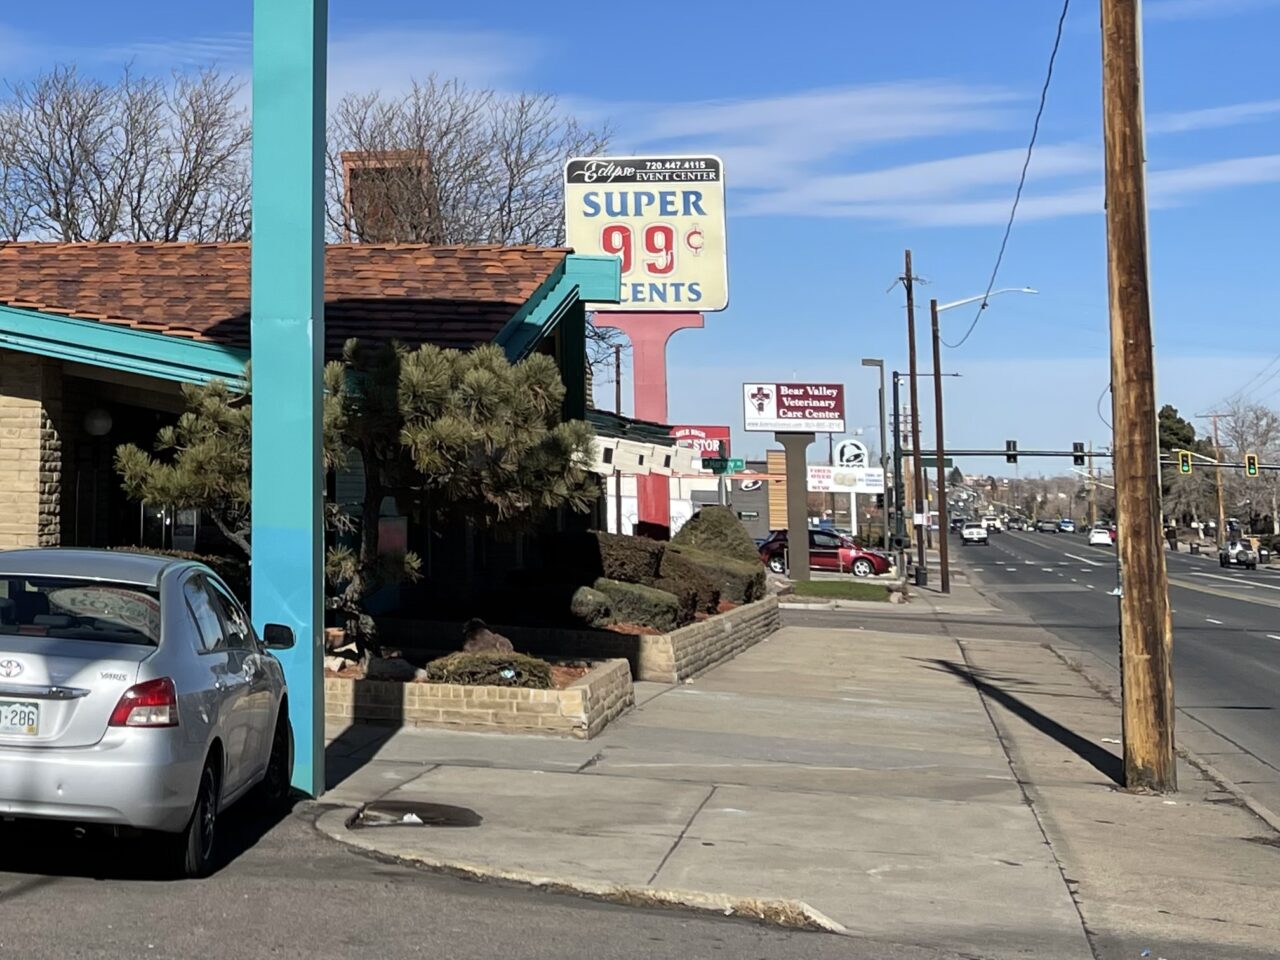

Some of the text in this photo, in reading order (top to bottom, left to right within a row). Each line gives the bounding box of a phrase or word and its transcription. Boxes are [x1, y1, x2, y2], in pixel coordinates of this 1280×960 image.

[645, 161, 706, 170] 720.447.4115
[571, 160, 636, 183] Eclipse
[636, 171, 717, 182] EVENT CENTER
[582, 191, 708, 218] SUPER
[780, 386, 838, 397] Bear Valley
[782, 397, 836, 409] Veterinary
[779, 408, 840, 419] Care Center
[692, 439, 720, 452] STOR
[100, 672, 128, 682] YARIS
